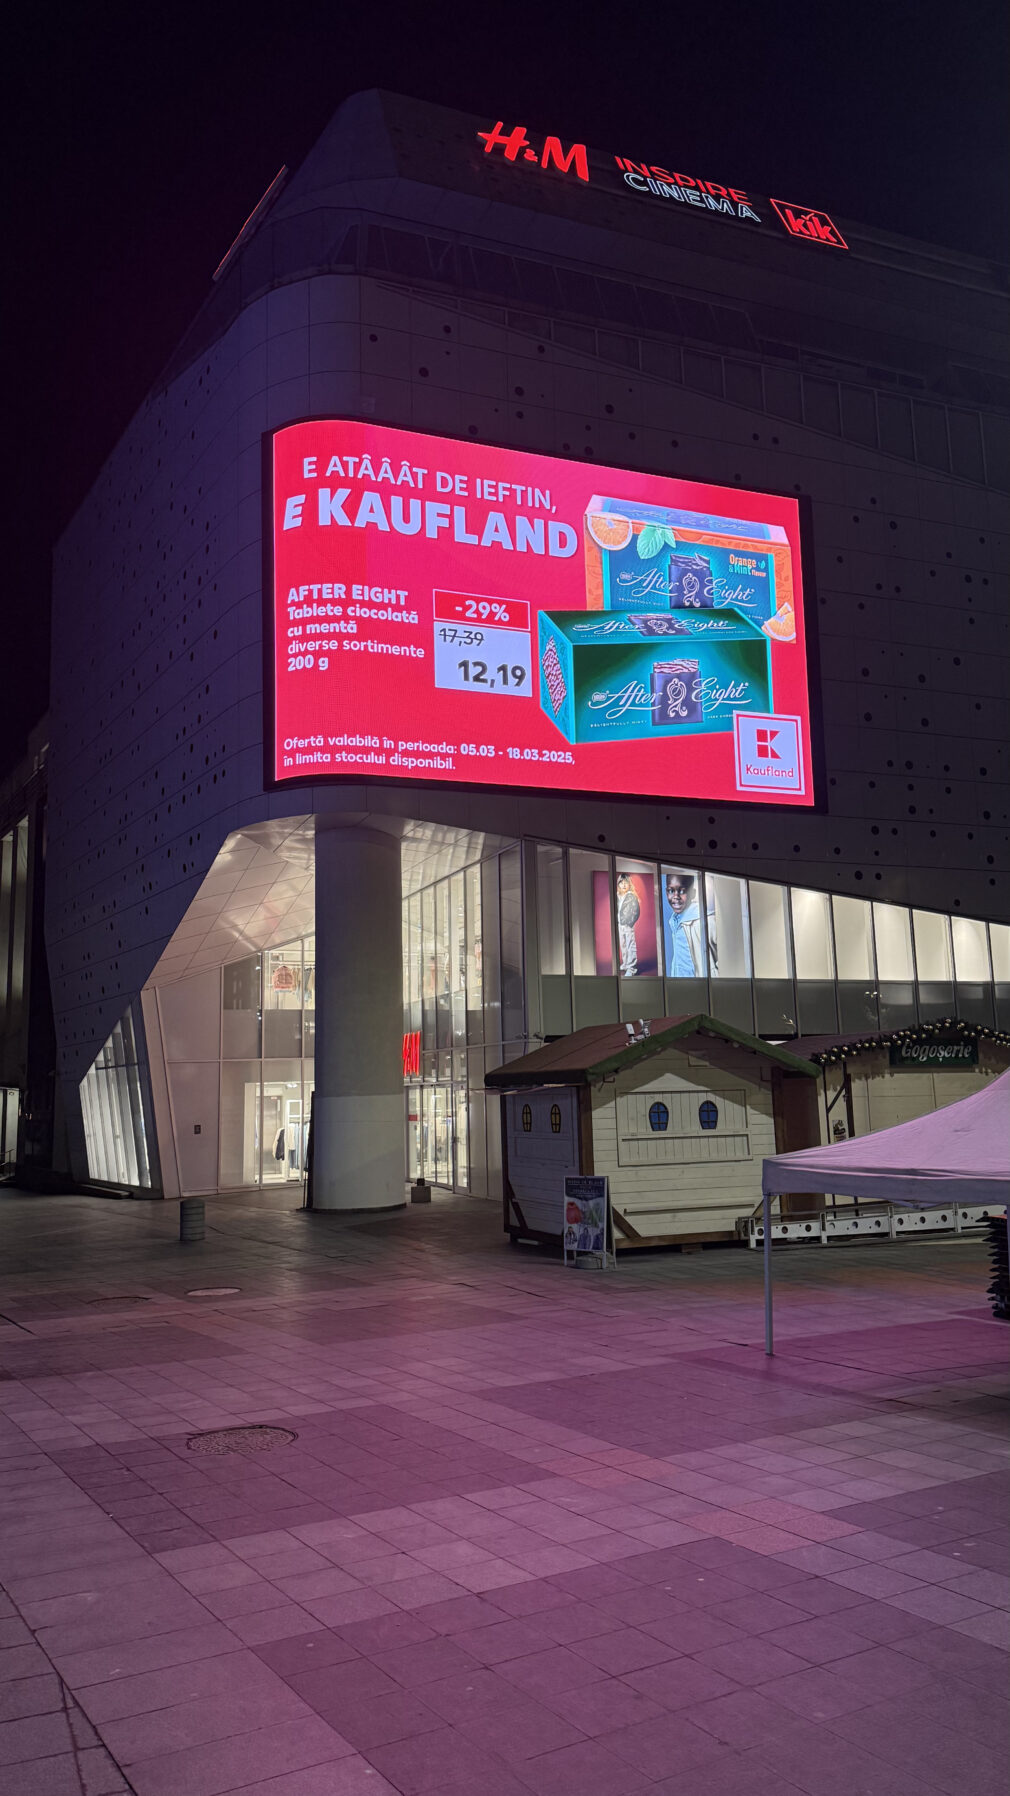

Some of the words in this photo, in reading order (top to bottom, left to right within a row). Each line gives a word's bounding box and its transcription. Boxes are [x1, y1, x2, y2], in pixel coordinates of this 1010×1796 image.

[477, 121, 589, 182] H&M
[615, 156, 753, 206] INSPIRE
[624, 172, 761, 222] CINEMA
[304, 457, 317, 478] E
[326, 454, 428, 489] ATÂÂÂT
[437, 472, 468, 497] DE
[476, 478, 556, 513] IEFTIN,
[283, 494, 305, 531] E
[318, 488, 578, 558] KAUFLAND
[729, 554, 757, 569] Orange
[287, 584, 346, 604] AFTER
[352, 585, 408, 606] EIGHT
[617, 568, 680, 597] After
[704, 577, 758, 608] Eight
[288, 604, 343, 621] Tablete
[347, 604, 418, 624] ciocolată
[455, 600, 510, 622] -29%
[287, 625, 303, 637] cu
[306, 621, 357, 634] mentă
[439, 628, 484, 647] 17,39
[288, 638, 338, 655] diverse
[343, 640, 425, 658] sortimente
[288, 655, 314, 671] 200
[318, 657, 329, 671] g
[458, 660, 527, 688] 12,19
[588, 680, 663, 719] After
[691, 677, 752, 712] Eight
[284, 735, 324, 750] Ofertă
[328, 734, 380, 748] valabilă
[383, 736, 394, 749] în
[398, 739, 457, 755] perioada:
[460, 743, 495, 757] 05.03
[284, 755, 293, 767] în
[296, 752, 331, 764] limita
[335, 751, 386, 765] stocului
[389, 753, 456, 770] disponibil.
[745, 764, 794, 778] Kaufland
